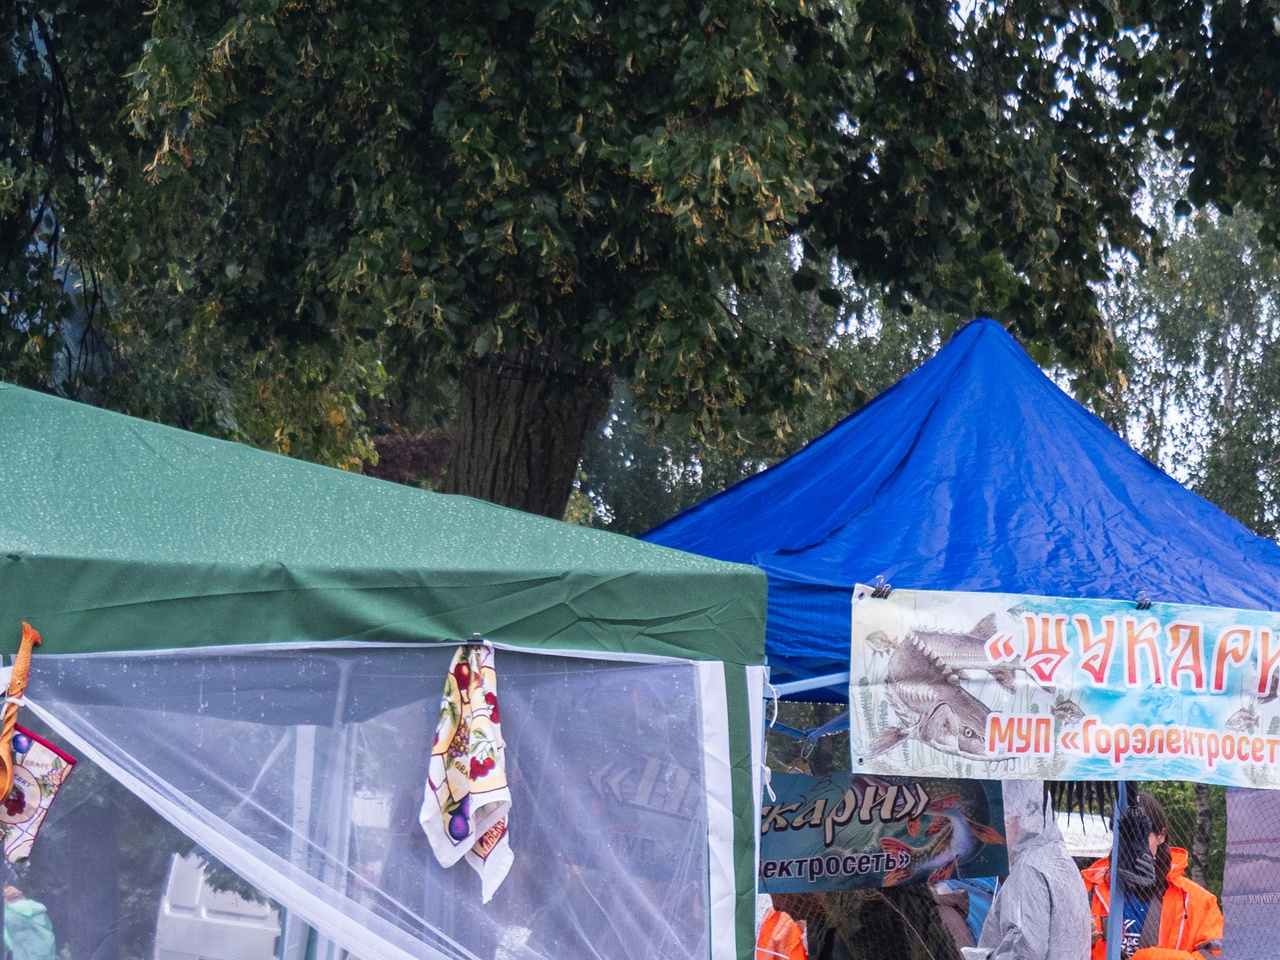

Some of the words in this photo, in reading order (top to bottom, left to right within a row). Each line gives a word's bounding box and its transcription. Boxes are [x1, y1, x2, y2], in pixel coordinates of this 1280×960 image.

[988, 716, 1051, 754] МУП
[761, 782, 931, 846] кари»
[759, 852, 911, 883] ектросеть»
